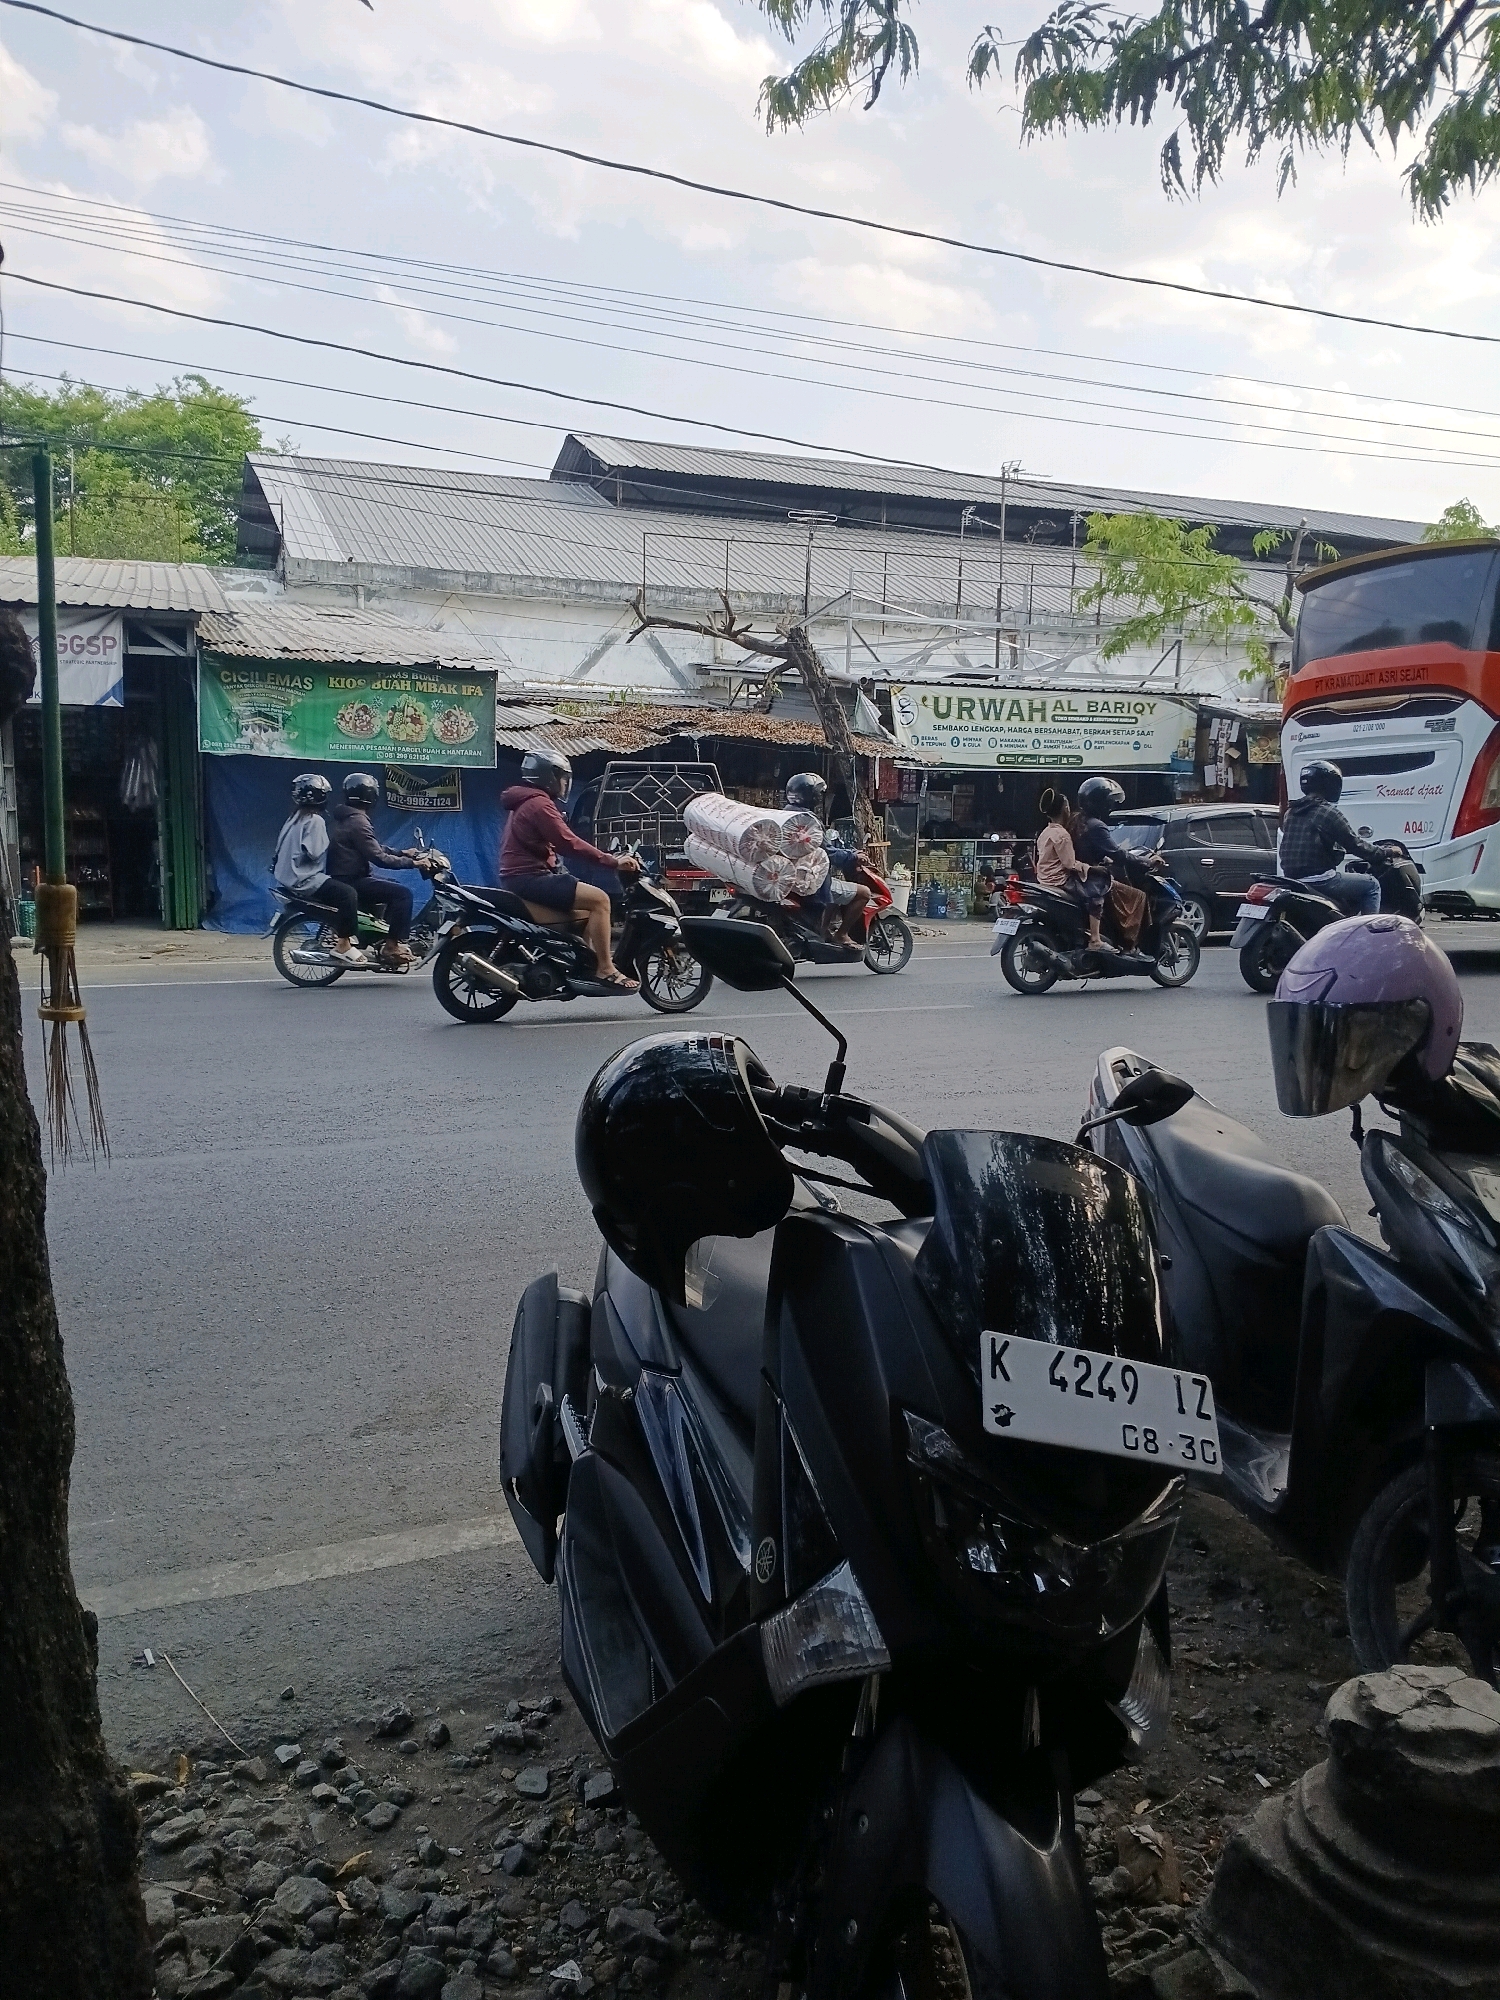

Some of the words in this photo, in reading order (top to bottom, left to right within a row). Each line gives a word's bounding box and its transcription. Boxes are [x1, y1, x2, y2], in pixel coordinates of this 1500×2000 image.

[266, 672, 313, 690] EMAS
[328, 677, 366, 690] KIOS
[371, 679, 411, 692] BUAH
[415, 680, 458, 695] MBAK
[461, 685, 484, 697] IFA
[1315, 679, 1323, 693] PT
[1378, 670, 1398, 684] ASRI
[1400, 667, 1429, 682] SEJATI
[1052, 699, 1078, 713] AL
[1087, 701, 1158, 716] BARIQY
[932, 724, 969, 732] SEMBAKO
[1007, 726, 1032, 734] HARGA
[1112, 729, 1136, 737] SETIAP
[447, 749, 482, 757] HANTARAN
[1376, 784, 1415, 797] Kramat
[1417, 784, 1444, 799] djati
[990, 1336, 1011, 1382] K
[1049, 1350, 1139, 1405] 4249
[1173, 1374, 1212, 1421] IZ
